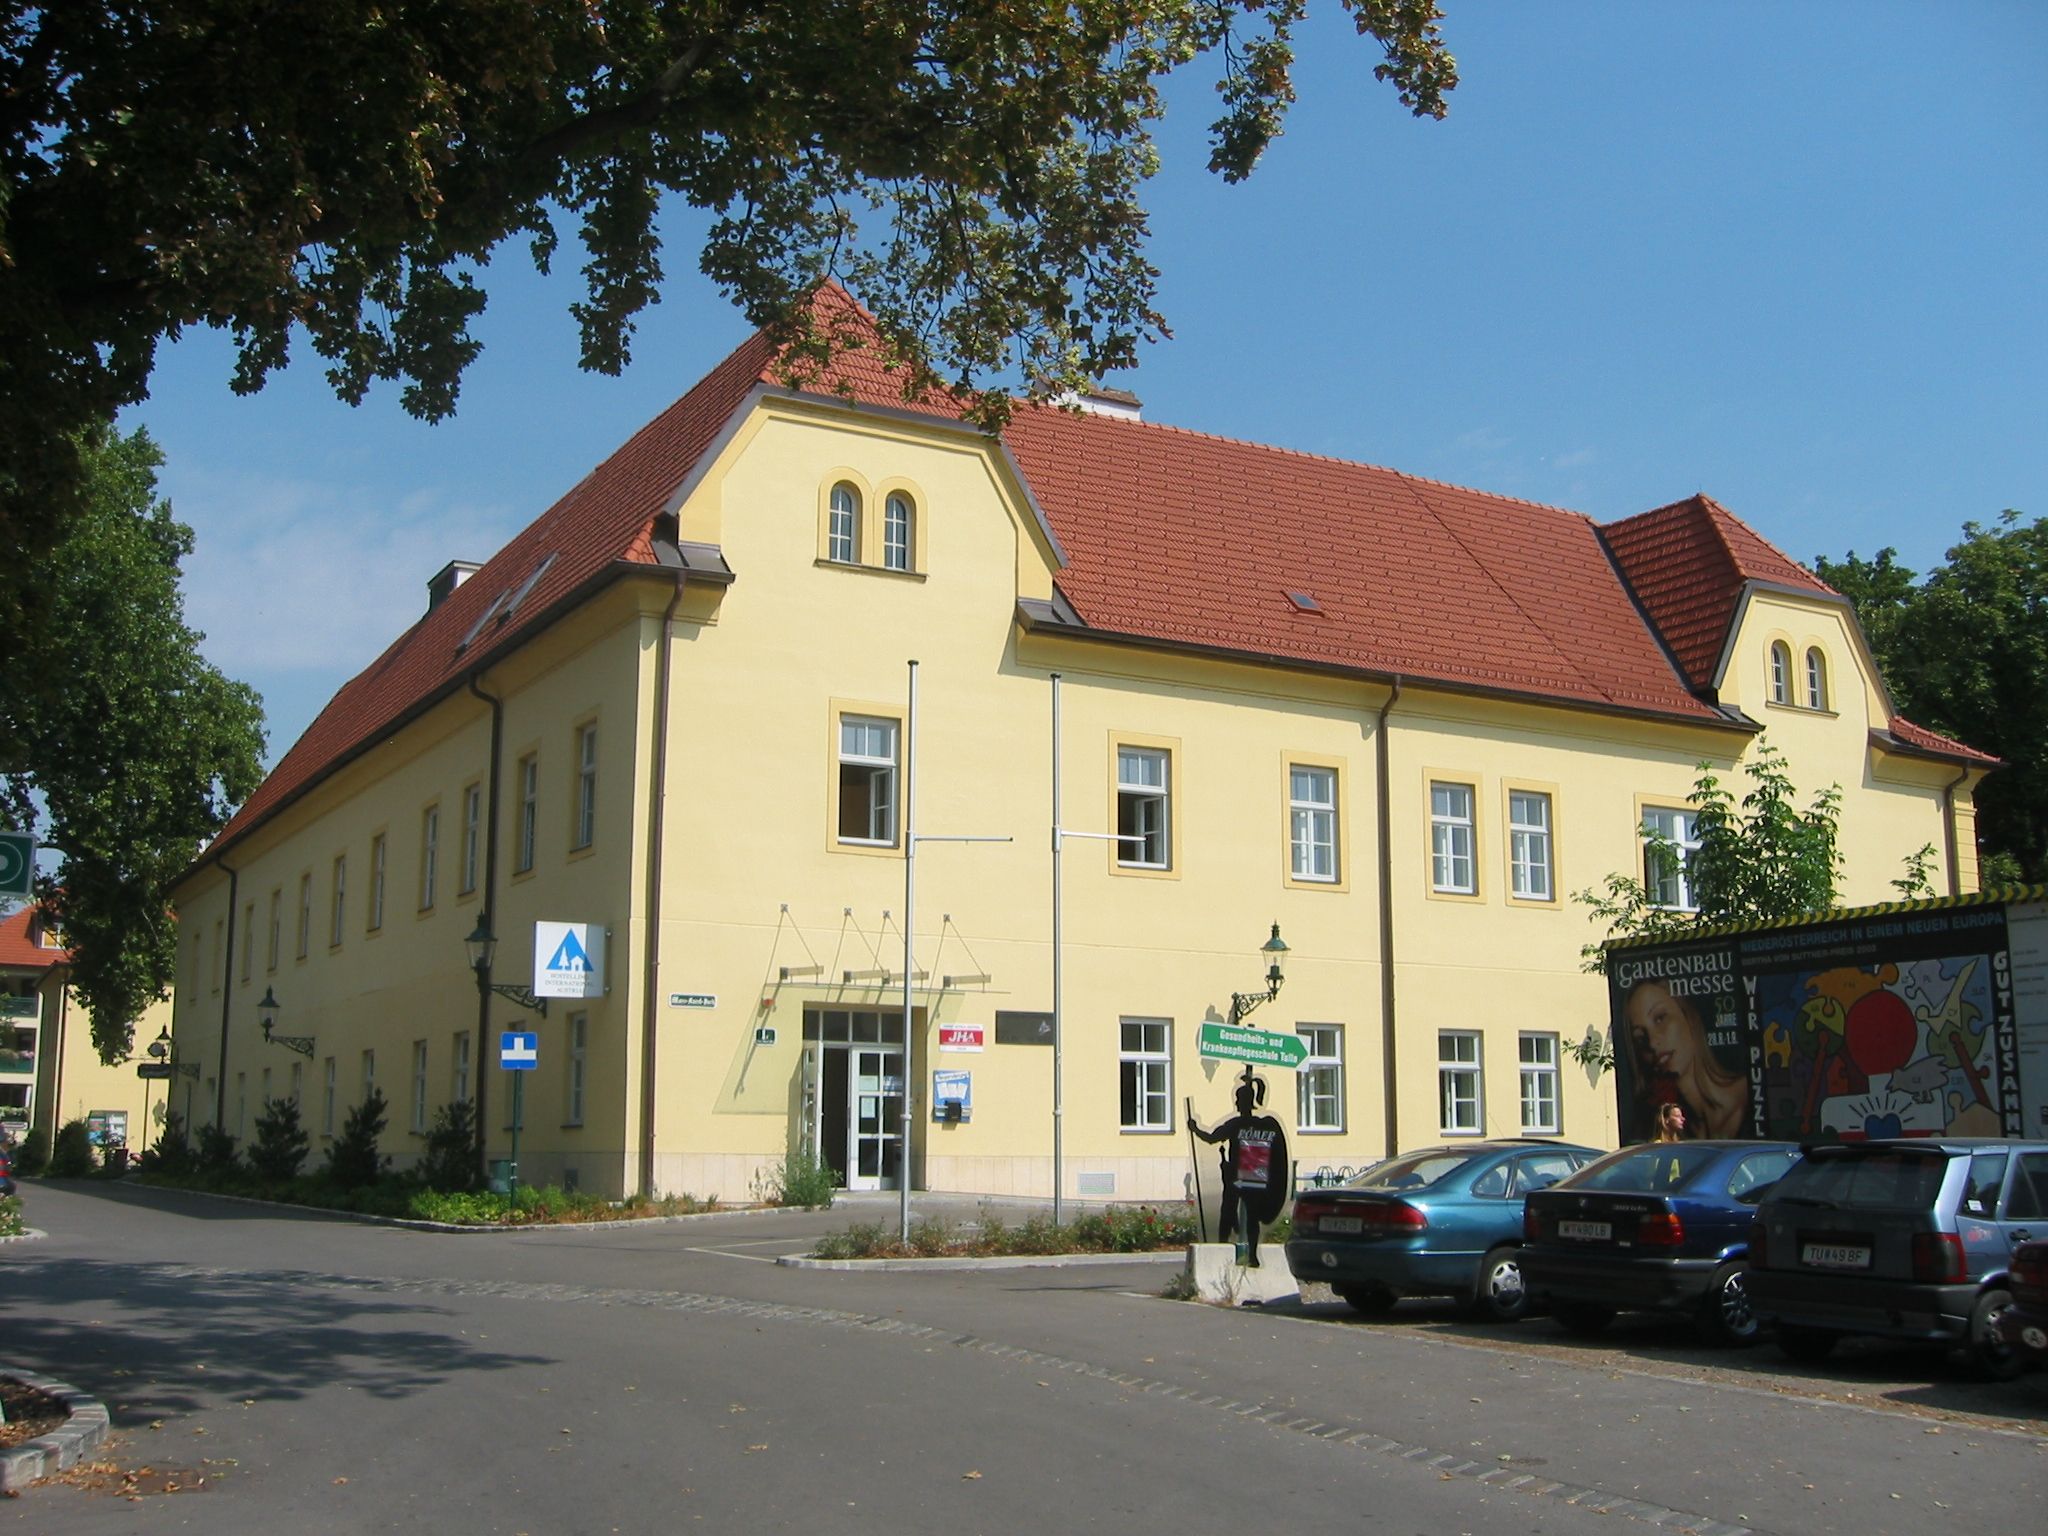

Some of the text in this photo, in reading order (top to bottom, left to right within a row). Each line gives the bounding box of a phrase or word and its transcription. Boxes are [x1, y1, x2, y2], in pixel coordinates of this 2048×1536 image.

[1741, 929, 1847, 952] NIEDERÖSTERREICH
[1851, 928, 1863, 940] IN
[1866, 924, 1904, 938] EINEM
[1906, 919, 1949, 934] NEUEN
[1952, 912, 2004, 930] EUROPA
[1669, 974, 1734, 997] messe
[1993, 950, 2011, 1009] GUT
[1742, 976, 1759, 1031] WIR
[948, 1031, 975, 1043] JHA
[1220, 1029, 1283, 1048] Gesundheits- und
[1202, 1041, 1298, 1063] Krankenpflegeschule Tulln
[1238, 1126, 1276, 1142] RÖMER
[1810, 1247, 1823, 1260] TU
[1832, 1248, 1845, 1262] 49
